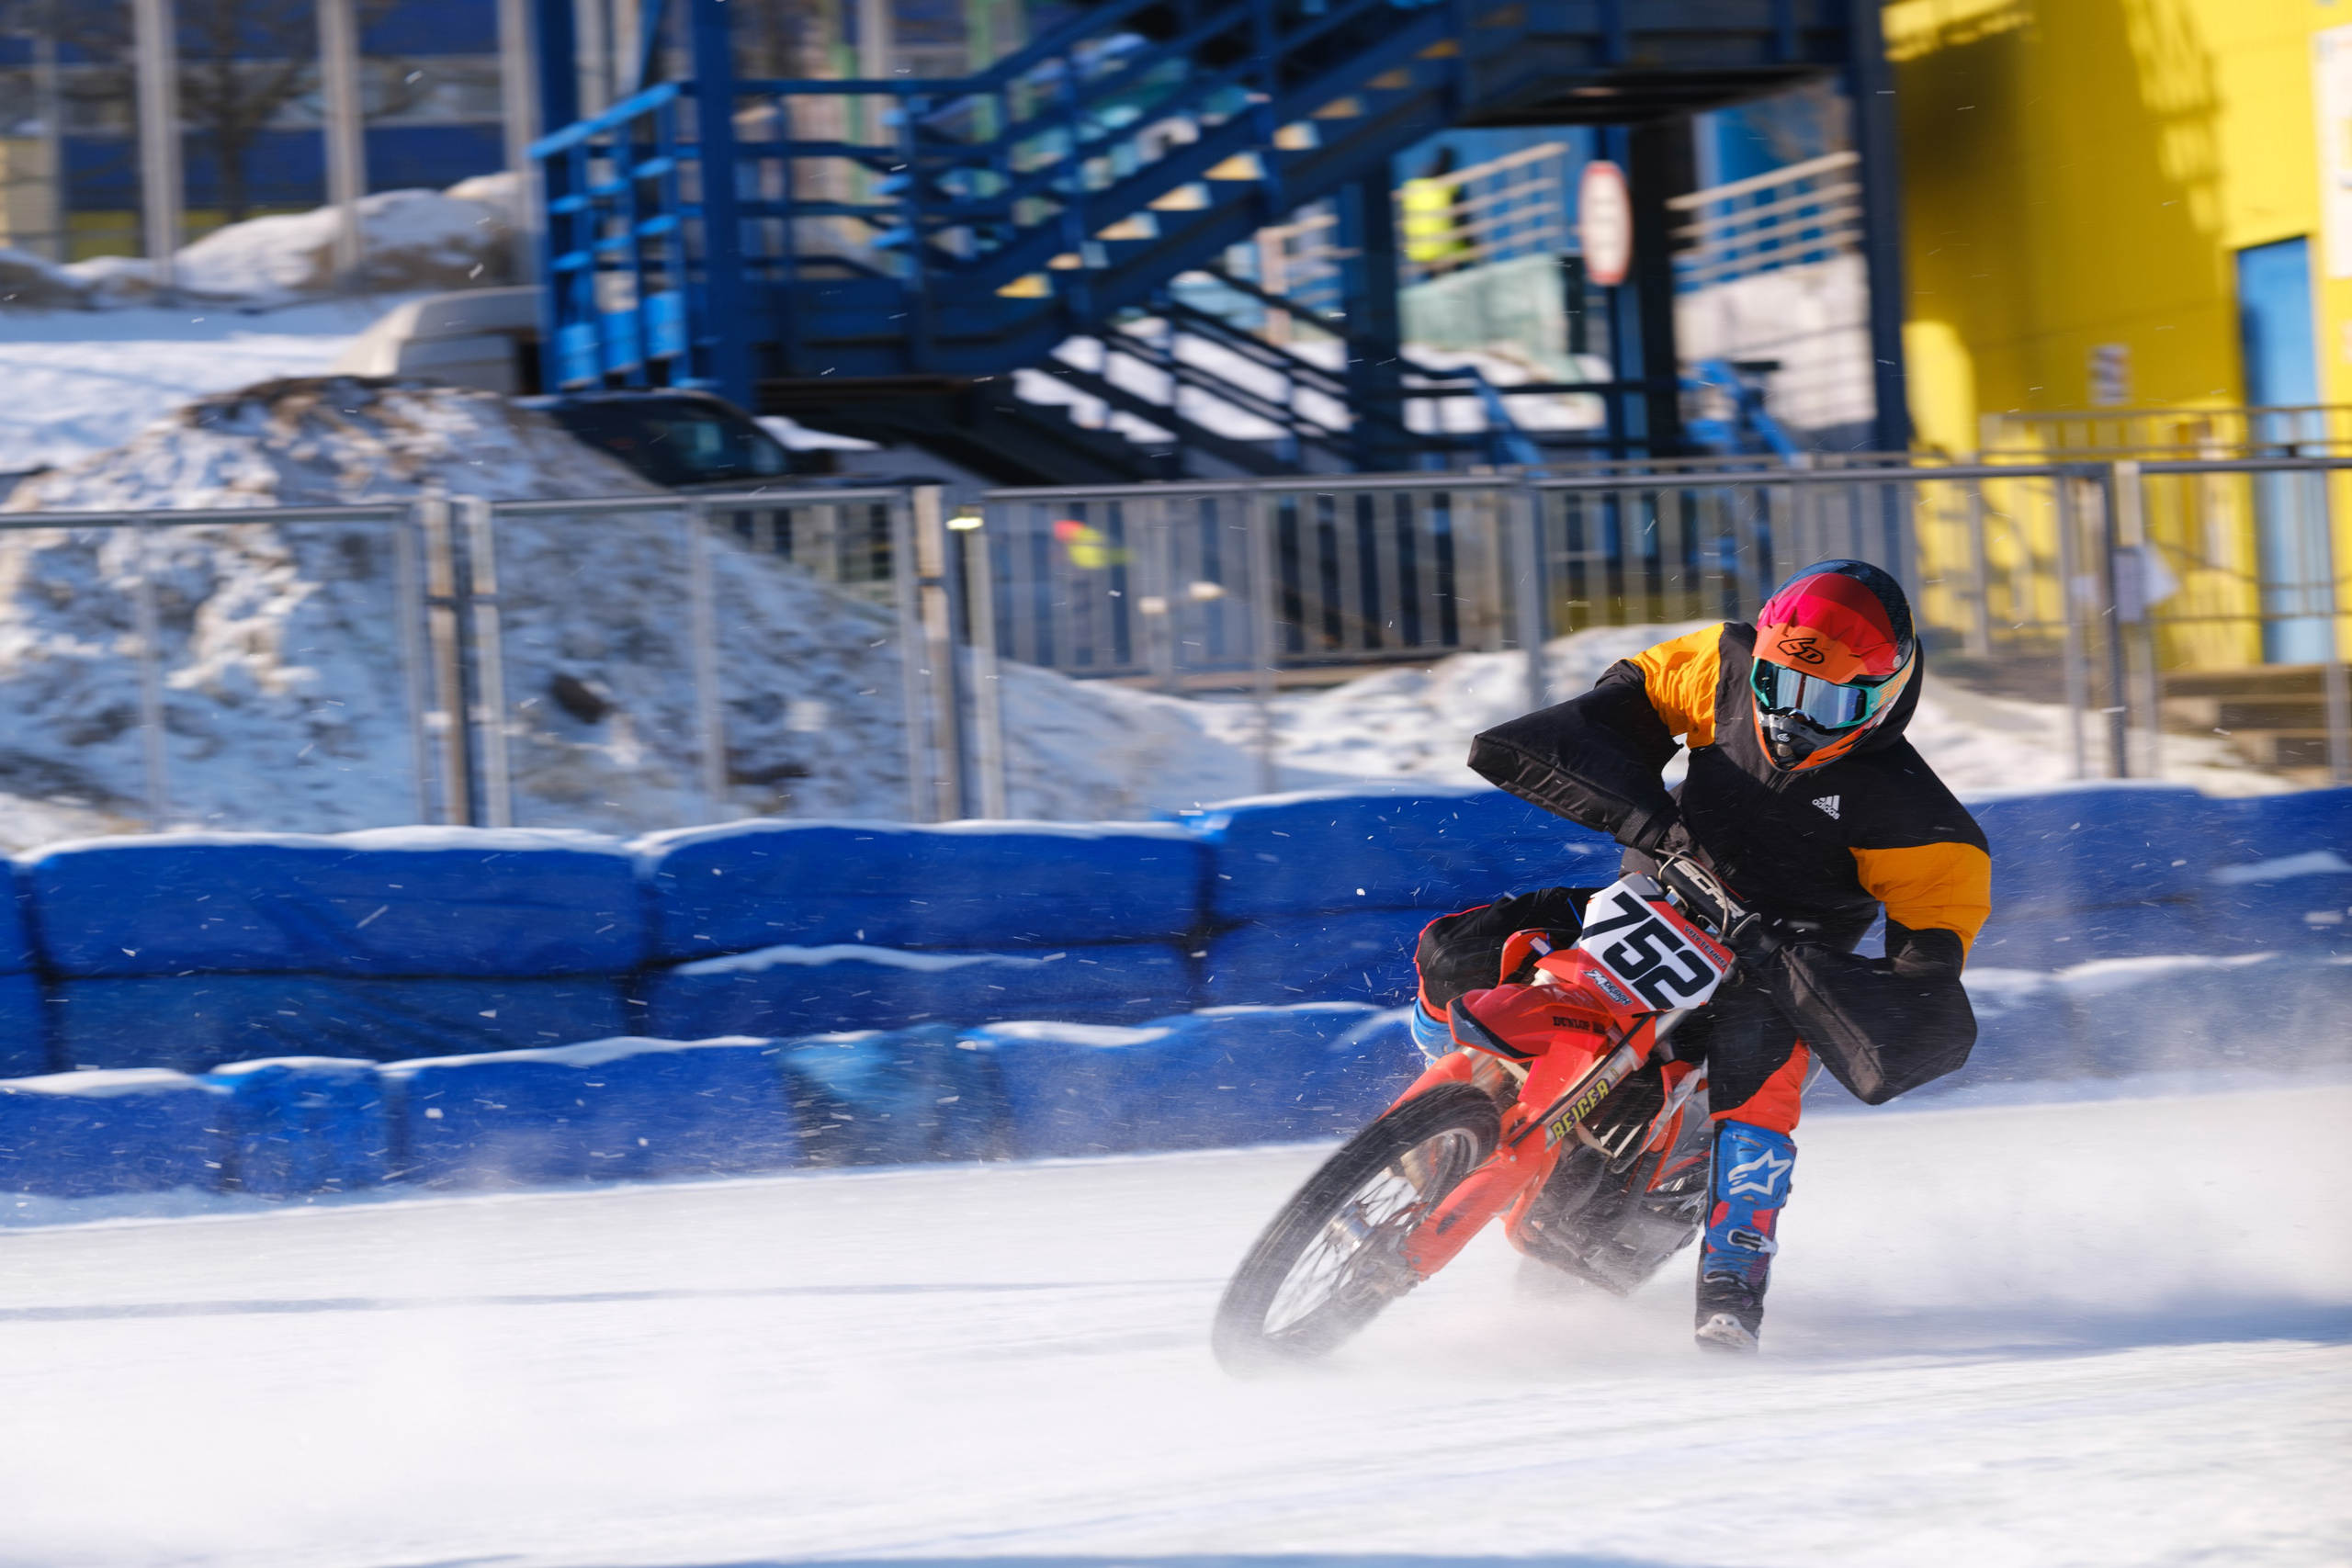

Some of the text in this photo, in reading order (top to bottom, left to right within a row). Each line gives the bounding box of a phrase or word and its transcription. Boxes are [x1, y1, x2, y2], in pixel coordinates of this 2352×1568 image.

[1812, 798, 1840, 819] adidas
[1673, 860, 1747, 919] SCAR
[1581, 891, 1715, 1010] 752
[1553, 1016, 1590, 1030] DUNLOP
